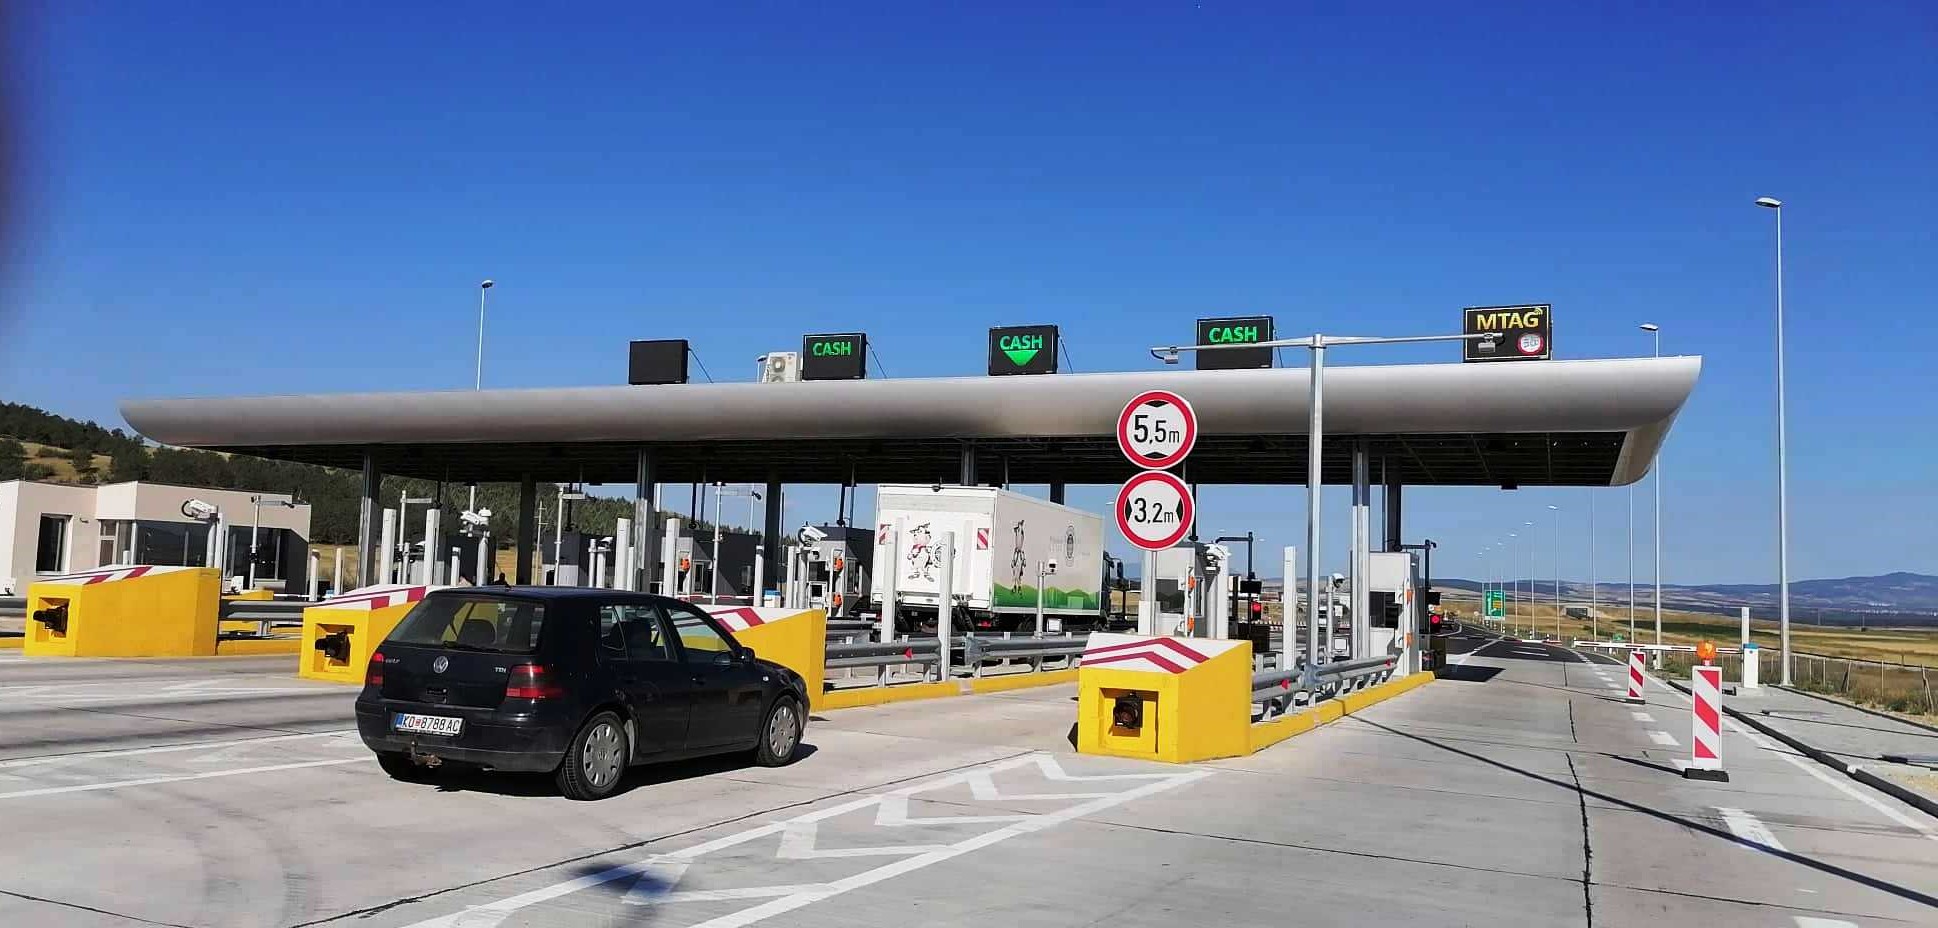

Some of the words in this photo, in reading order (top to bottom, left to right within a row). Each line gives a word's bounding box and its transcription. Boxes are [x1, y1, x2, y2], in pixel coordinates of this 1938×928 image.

[1477, 311, 1539, 330] MTAG
[999, 334, 1043, 350] CASH
[1208, 326, 1258, 343] CASH
[812, 341, 852, 356] CASH
